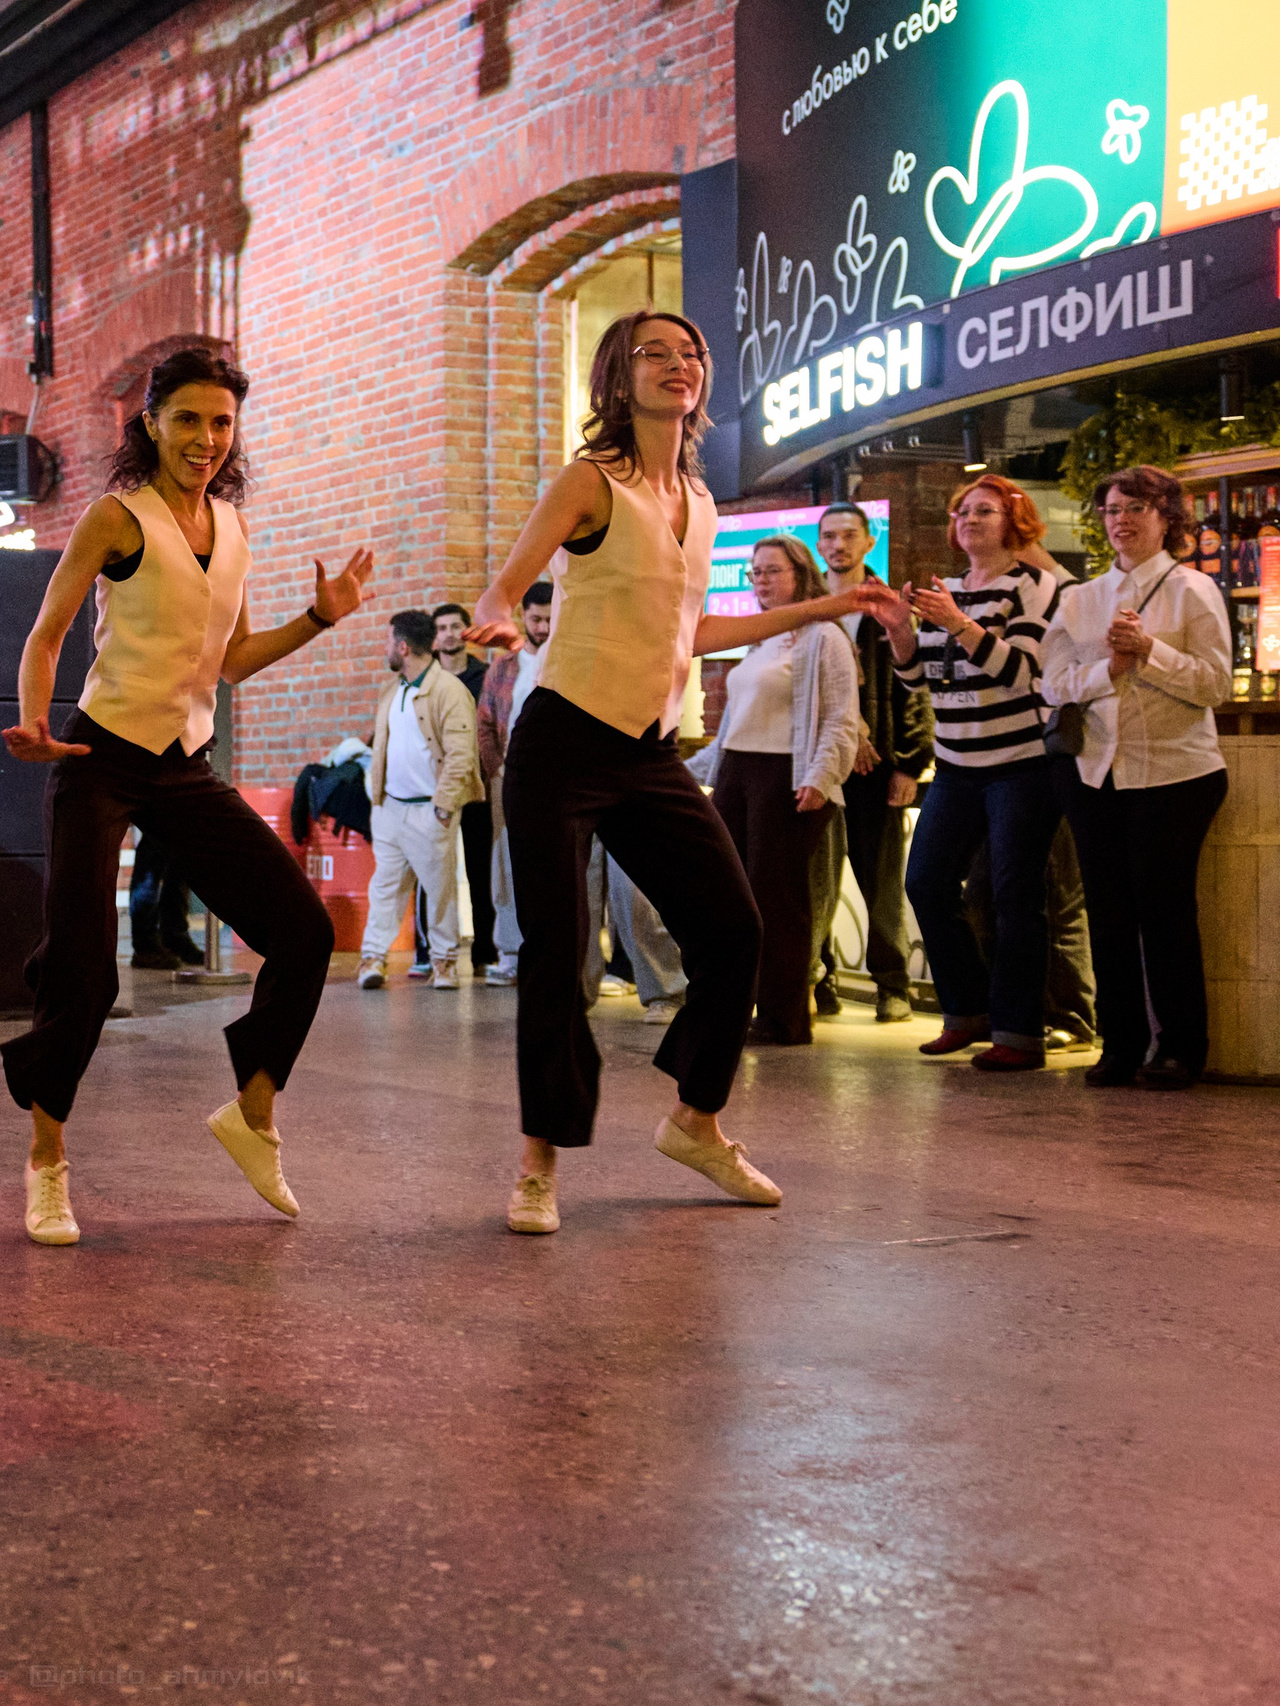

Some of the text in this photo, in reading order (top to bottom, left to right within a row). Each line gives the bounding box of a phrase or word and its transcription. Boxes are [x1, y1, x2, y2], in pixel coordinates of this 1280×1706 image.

[782, 0, 958, 136] с любовью к себе
[957, 259, 1194, 370] СЕЛФИШ
[763, 321, 923, 447] SELFISH
